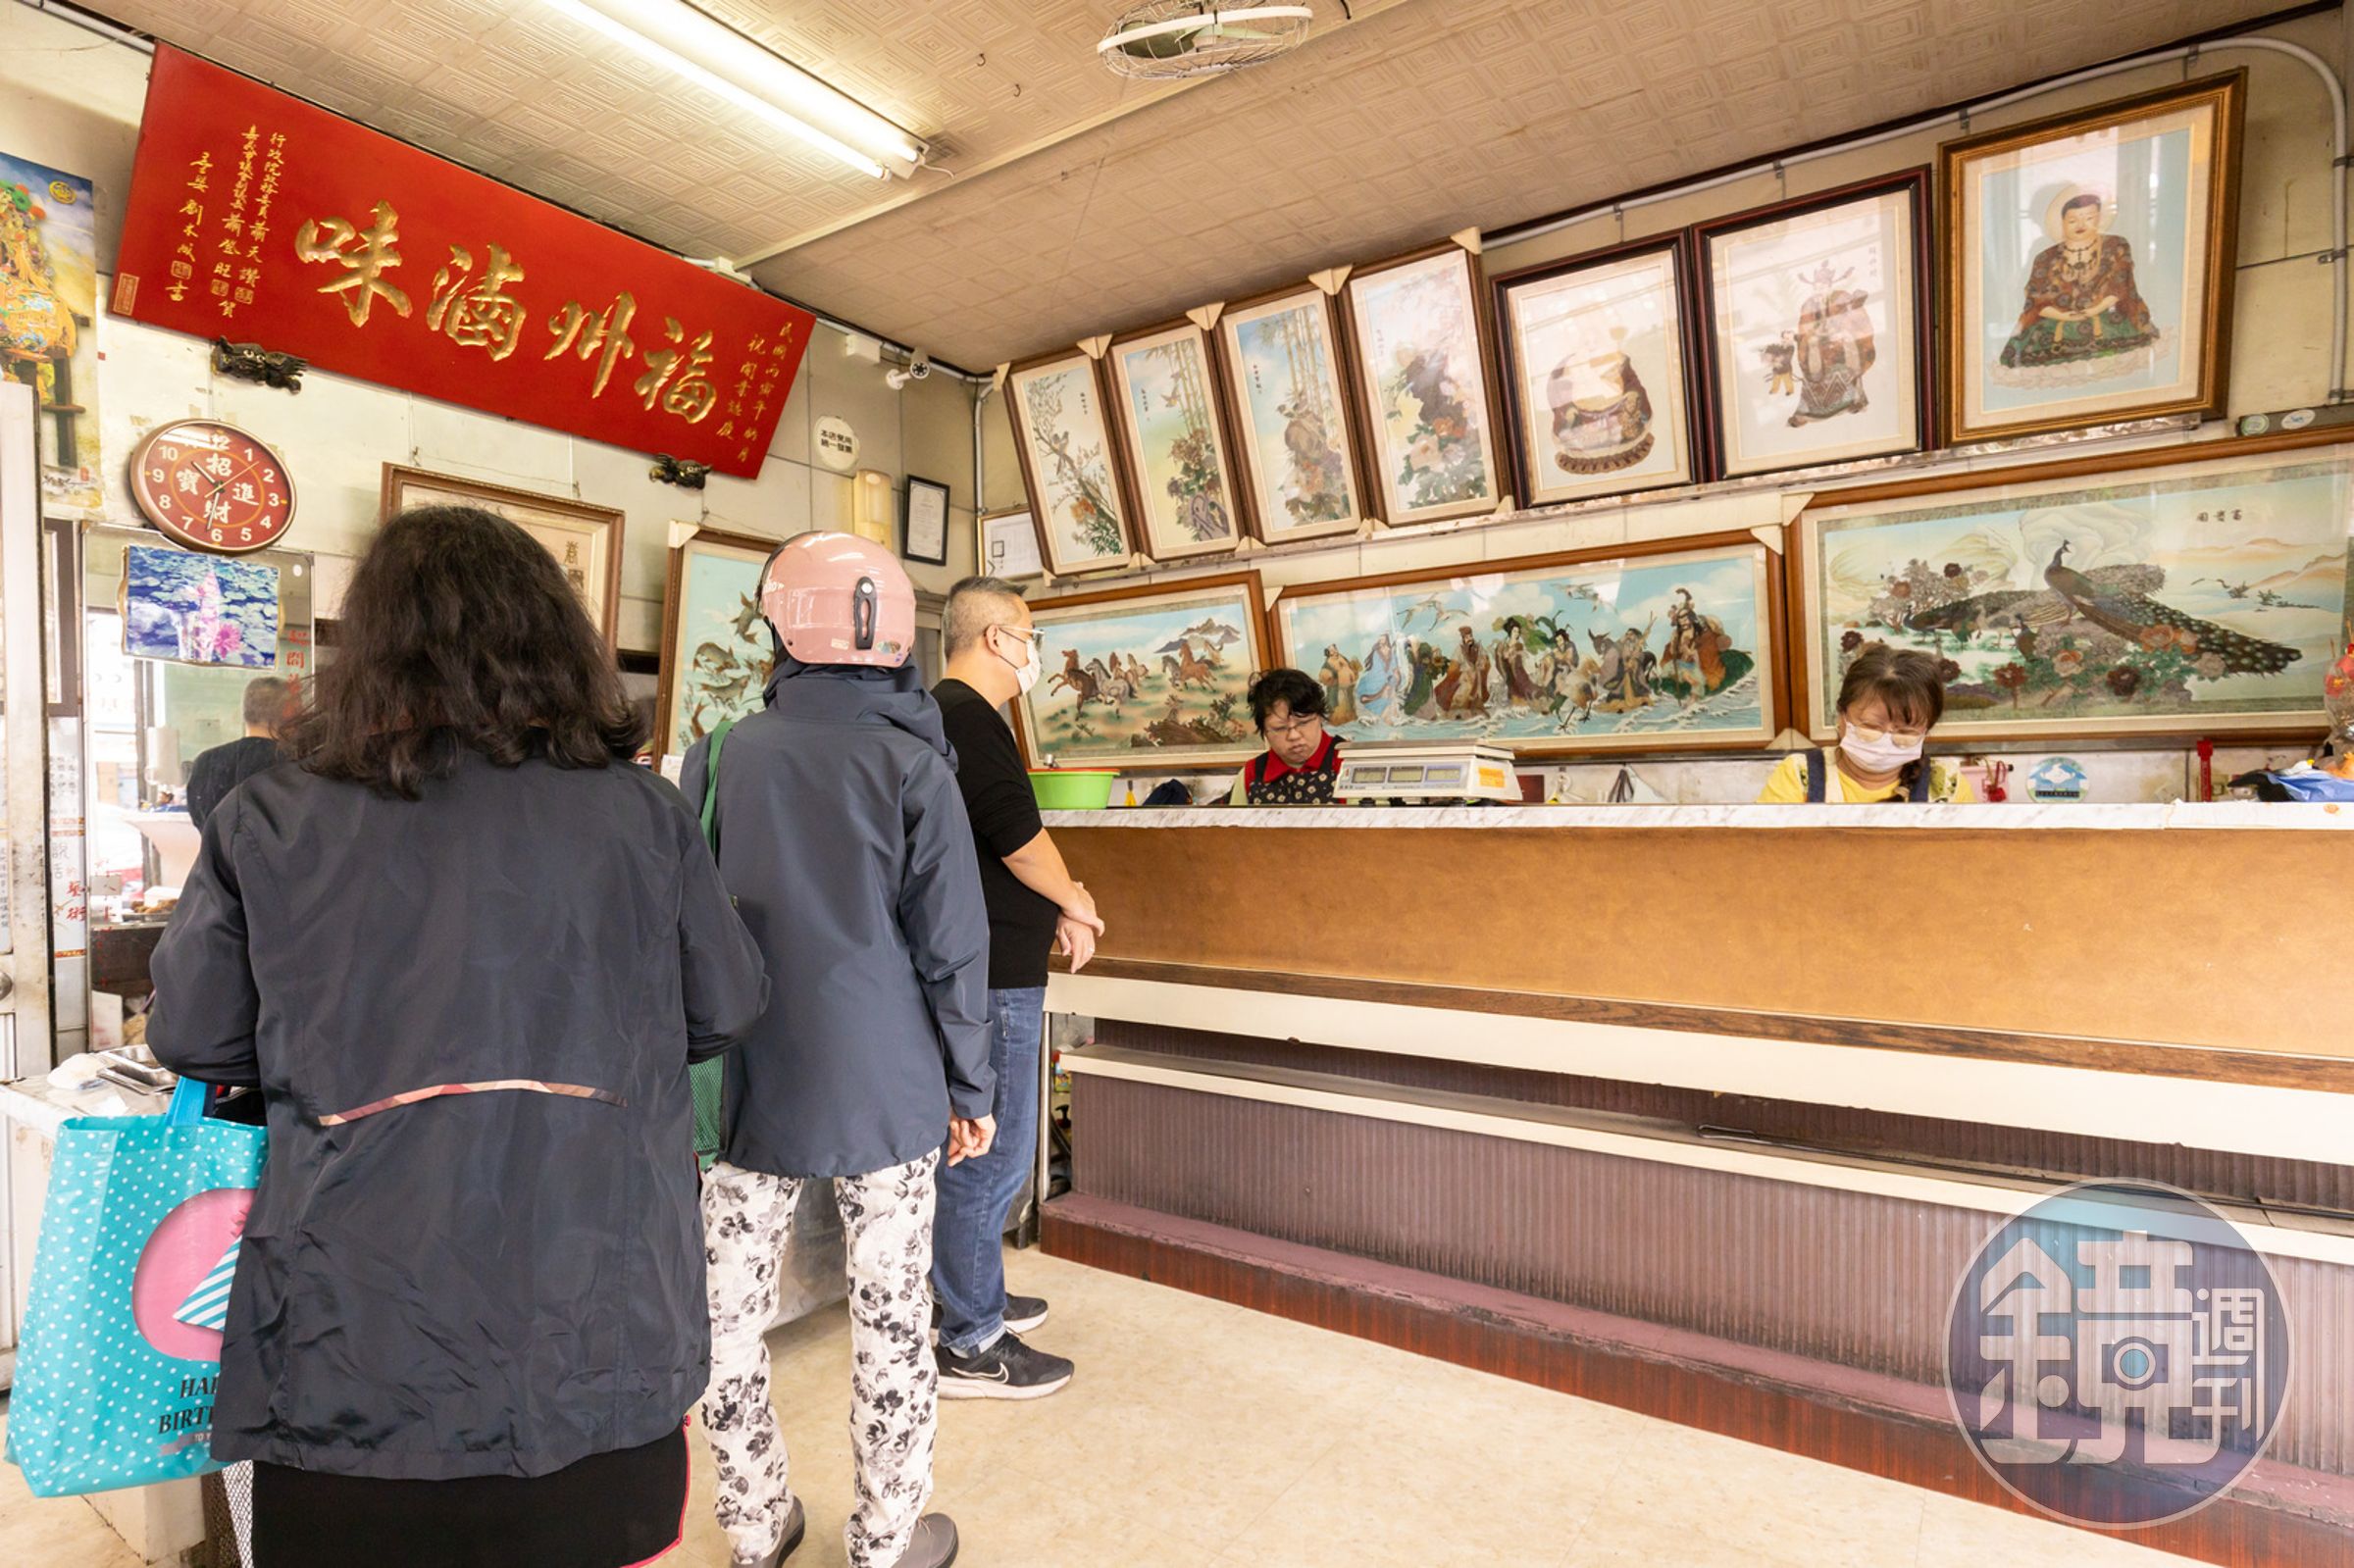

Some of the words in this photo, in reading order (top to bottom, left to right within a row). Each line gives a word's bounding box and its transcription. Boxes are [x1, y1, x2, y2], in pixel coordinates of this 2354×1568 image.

[159, 446, 179, 461] 10
[244, 448, 253, 462] 1
[152, 469, 165, 482] 9
[263, 469, 275, 482] 2
[159, 494, 172, 509] 8
[269, 493, 280, 507] 3
[181, 516, 194, 531] 7
[260, 516, 272, 529] 4
[211, 529, 223, 542] 6
[240, 528, 252, 541] 5
